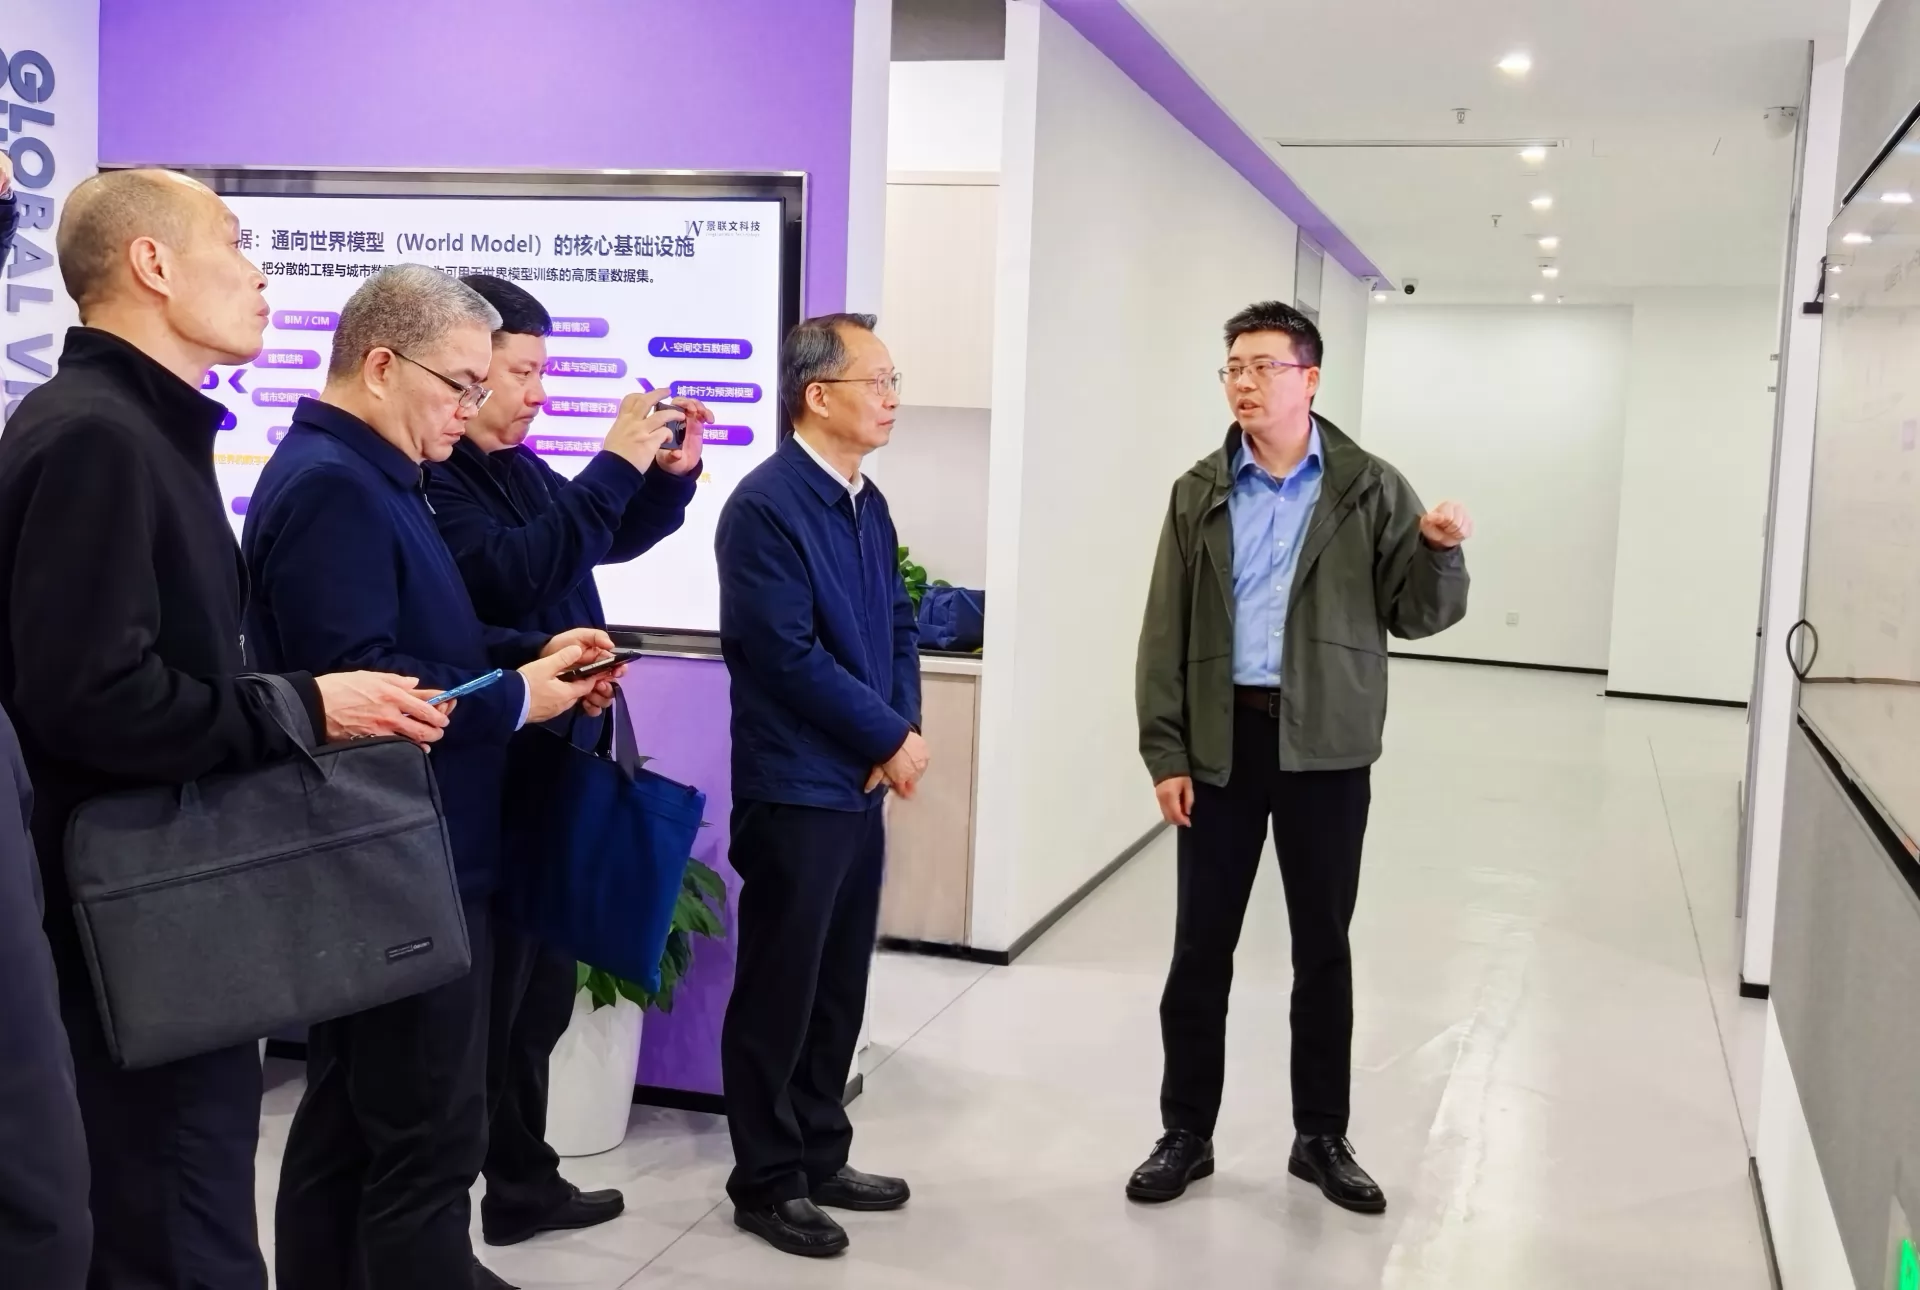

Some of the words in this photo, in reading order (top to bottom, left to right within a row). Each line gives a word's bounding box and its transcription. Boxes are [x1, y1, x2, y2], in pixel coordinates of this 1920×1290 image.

[7, 49, 55, 313] GLOBAL
[706, 221, 760, 231] 景联文科技
[284, 315, 302, 325] BIM
[311, 316, 330, 326] CIM
[660, 342, 740, 355] 人-空间交互数据集
[552, 361, 618, 373] 人流与空间互动
[5, 333, 53, 424] VI
[677, 385, 754, 398] 城市行为预测模型
[551, 400, 617, 413] 运维与管理行为
[536, 440, 603, 452] 能耗与活动关系
